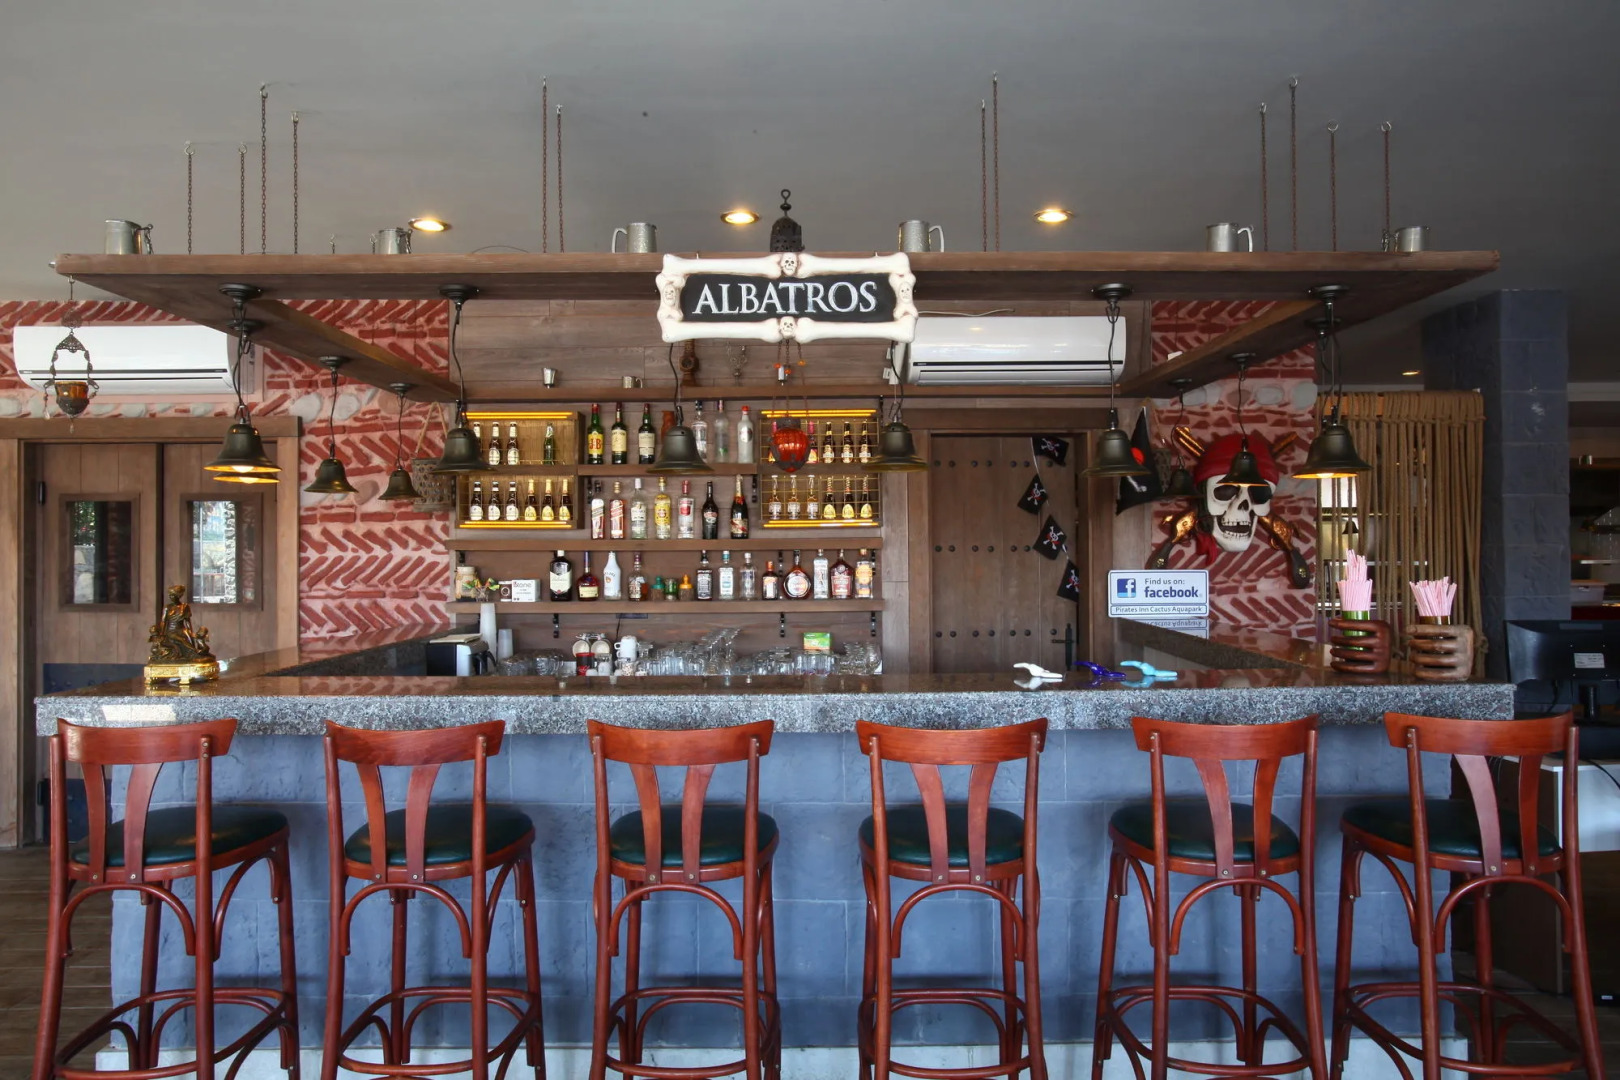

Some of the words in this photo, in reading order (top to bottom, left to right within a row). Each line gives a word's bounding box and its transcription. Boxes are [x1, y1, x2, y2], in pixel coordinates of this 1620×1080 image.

[692, 281, 877, 315] ALBATROS
[589, 438, 602, 449] JB
[1144, 586, 1199, 598] facebook
[1172, 606, 1202, 614] Aquapark
